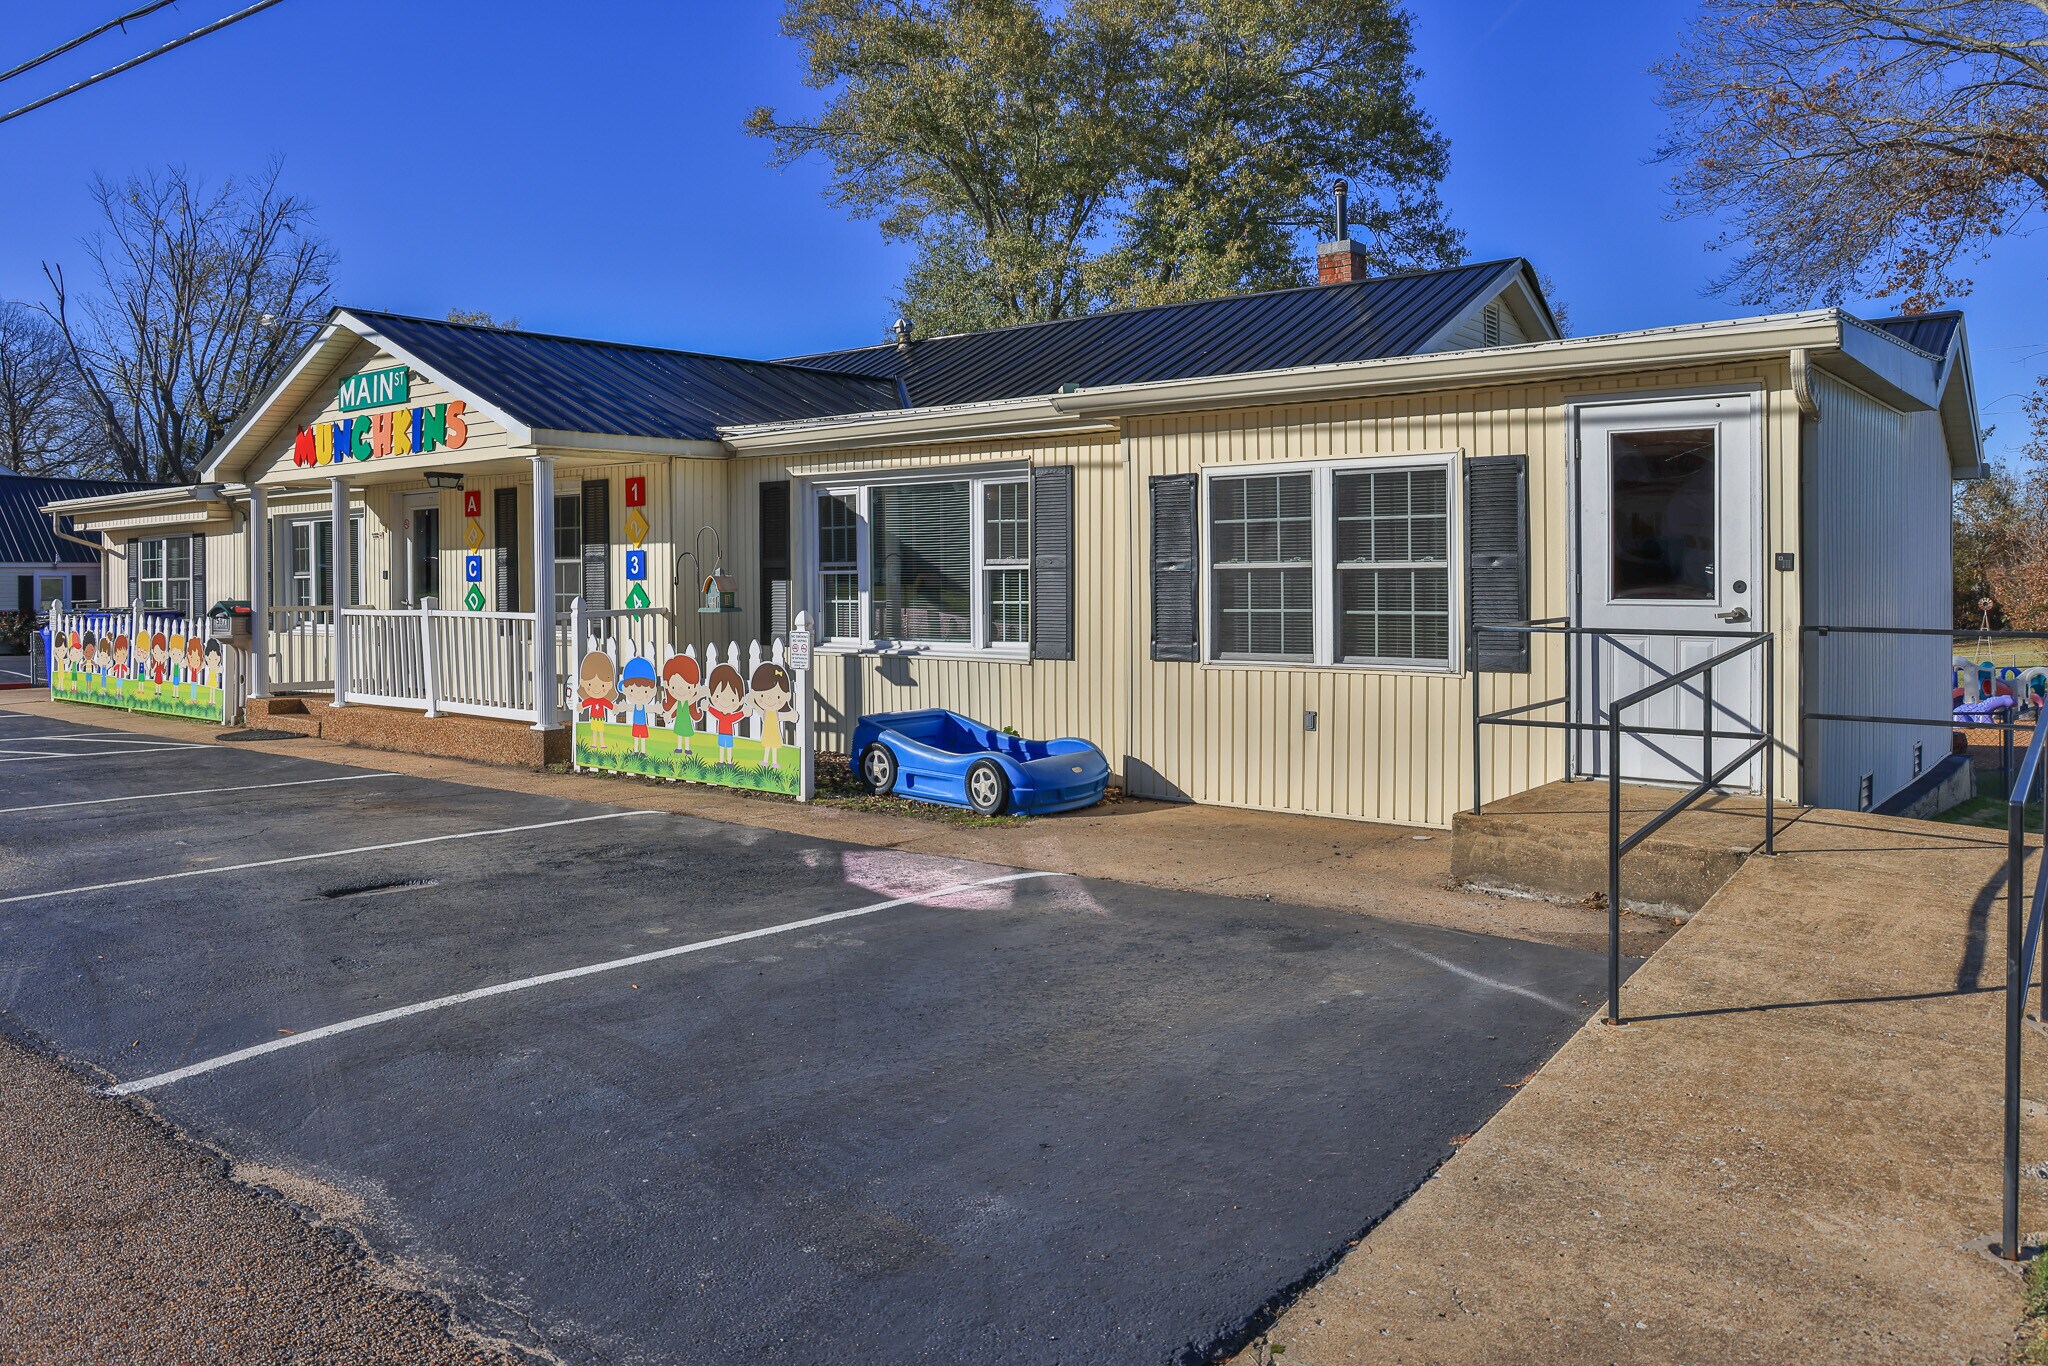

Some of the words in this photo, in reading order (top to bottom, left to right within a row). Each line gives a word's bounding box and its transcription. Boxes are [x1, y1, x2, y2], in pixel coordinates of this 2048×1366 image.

[340, 371, 393, 408] MAIN
[394, 371, 405, 386] ST
[294, 400, 467, 468] MUNCHKINS
[631, 483, 638, 501] 1
[467, 495, 477, 512] A
[468, 527, 478, 545] B
[630, 520, 642, 538] 2
[468, 560, 477, 577] C
[630, 555, 639, 575] 3
[468, 592, 479, 611] D
[633, 593, 643, 610] 4
